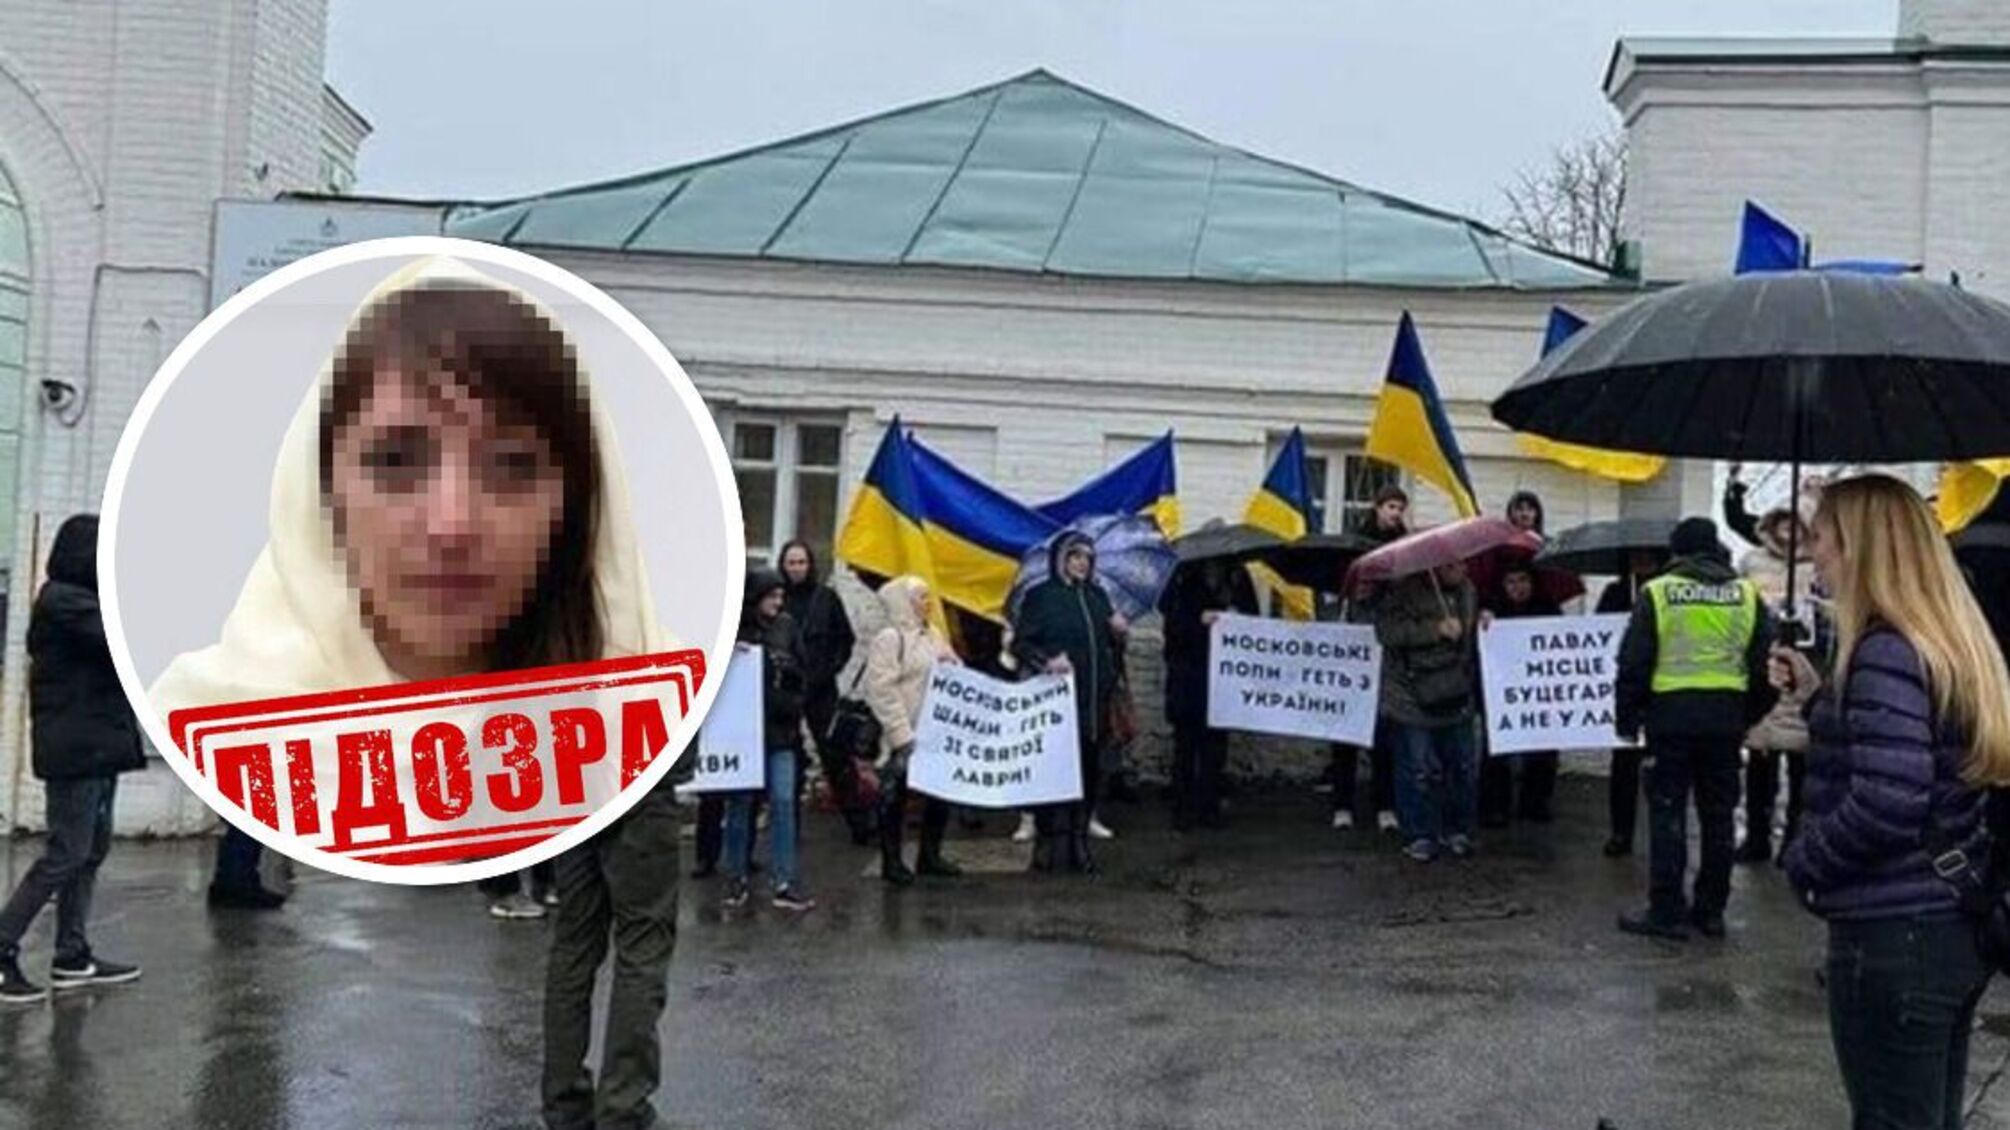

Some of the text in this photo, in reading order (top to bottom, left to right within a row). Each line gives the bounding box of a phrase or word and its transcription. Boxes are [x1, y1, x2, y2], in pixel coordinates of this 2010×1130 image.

[1222, 634, 1371, 661] МОСКОВСЬКІ
[1530, 631, 1614, 650] ПАВЛУ
[1219, 661, 1371, 690] ПОПИ ГЕТЬ З
[1526, 658, 1603, 677] МІСЦЕ
[932, 676, 1070, 712] МОСКОВСЬКИЙ
[1241, 690, 1345, 715] УКРАЇНИ!
[933, 703, 1063, 735] ШАМАН ГЕТЬ
[1500, 714, 1512, 731] А
[1520, 712, 1549, 729] НЕ
[1558, 710, 1574, 727] У
[967, 734, 1044, 762] СВЯТОЇ
[952, 767, 1031, 787] ЛАВРИ!
